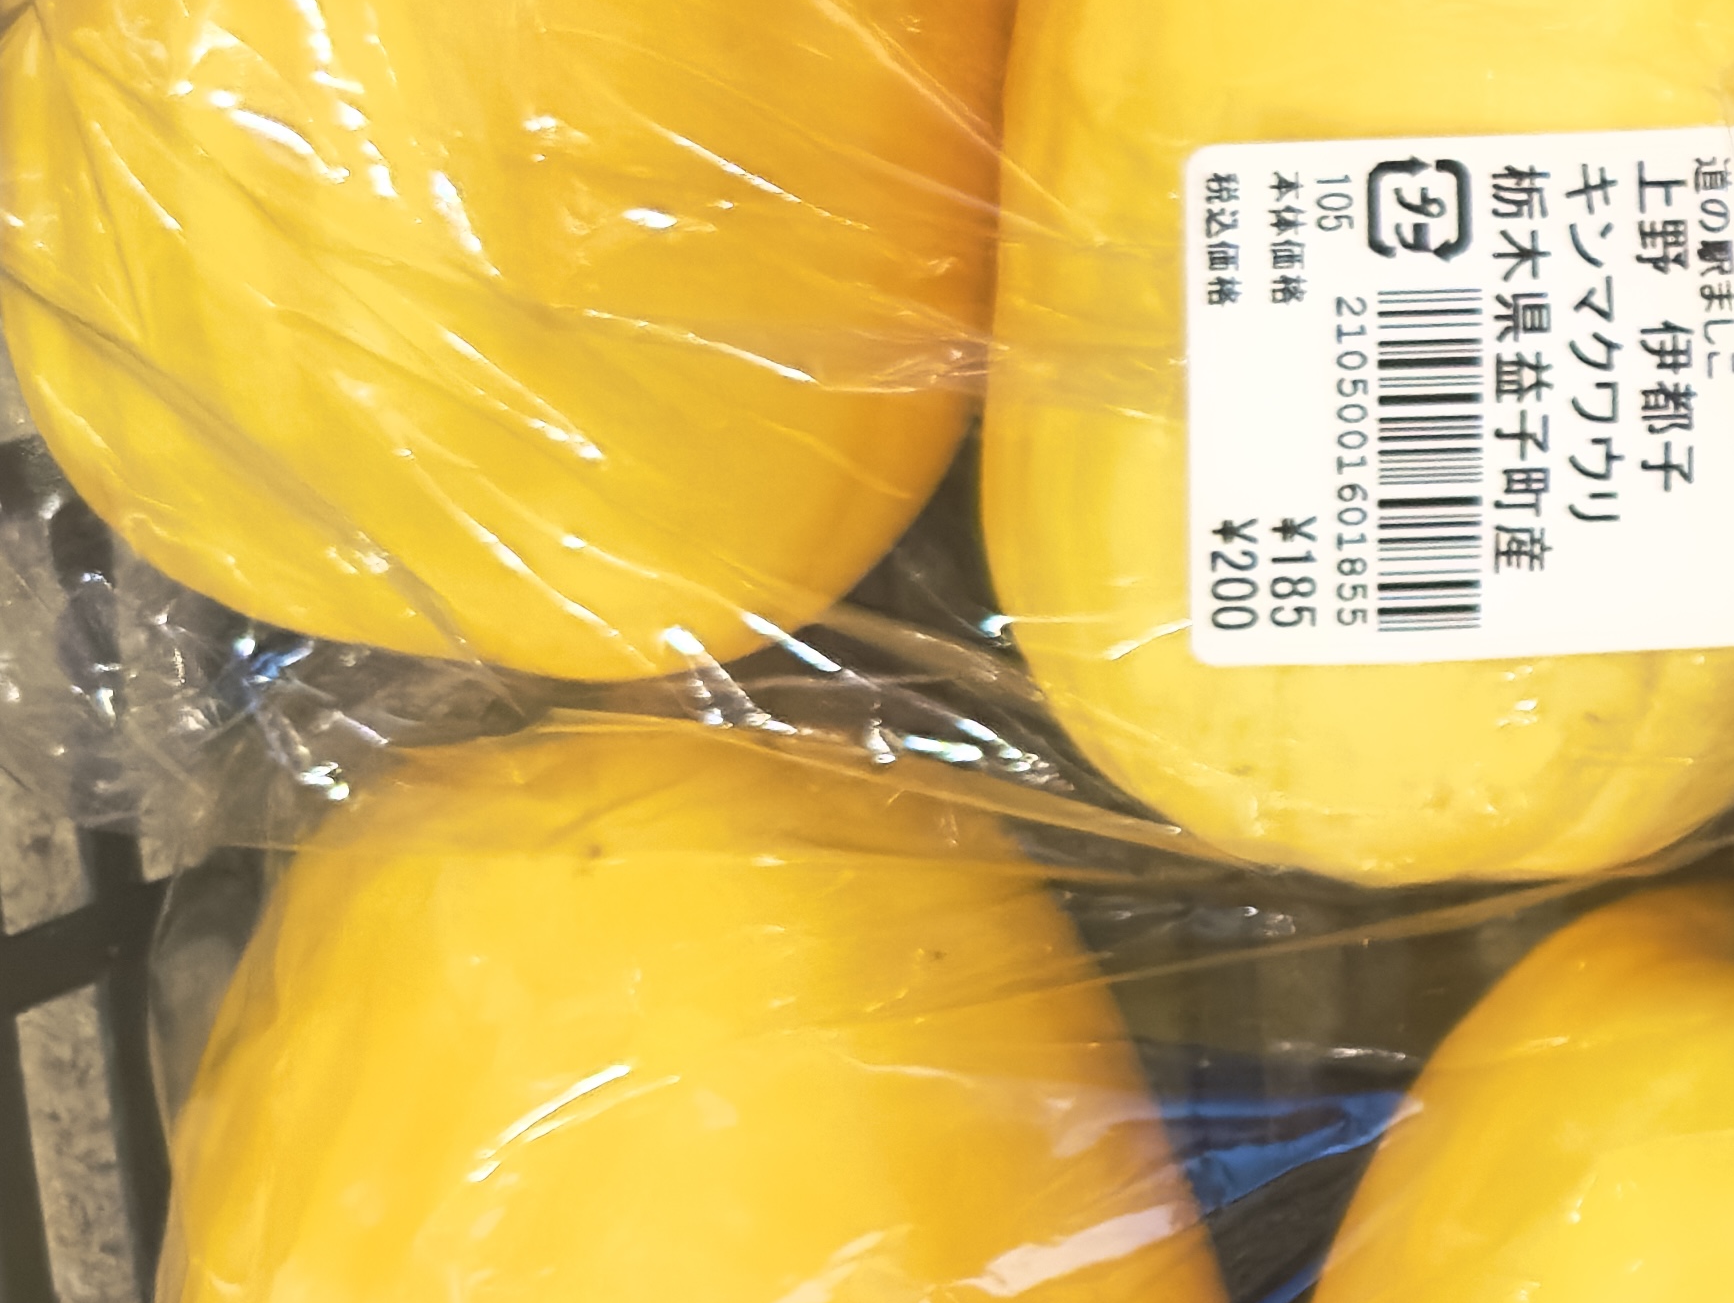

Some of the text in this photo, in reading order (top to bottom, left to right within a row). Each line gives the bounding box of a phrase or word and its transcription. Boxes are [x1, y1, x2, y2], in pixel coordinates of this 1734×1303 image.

[1314, 173, 1355, 233] 105
[1490, 164, 1554, 572] 栃木県益子町産
[1563, 162, 1625, 523] キンマクワウリ
[1634, 159, 1698, 493] 上野 伊都子
[1203, 171, 1260, 632] 税込価格 ¥200
[1266, 170, 1318, 629] 本体価格 ¥185
[1334, 295, 1370, 628] 2105001601855
